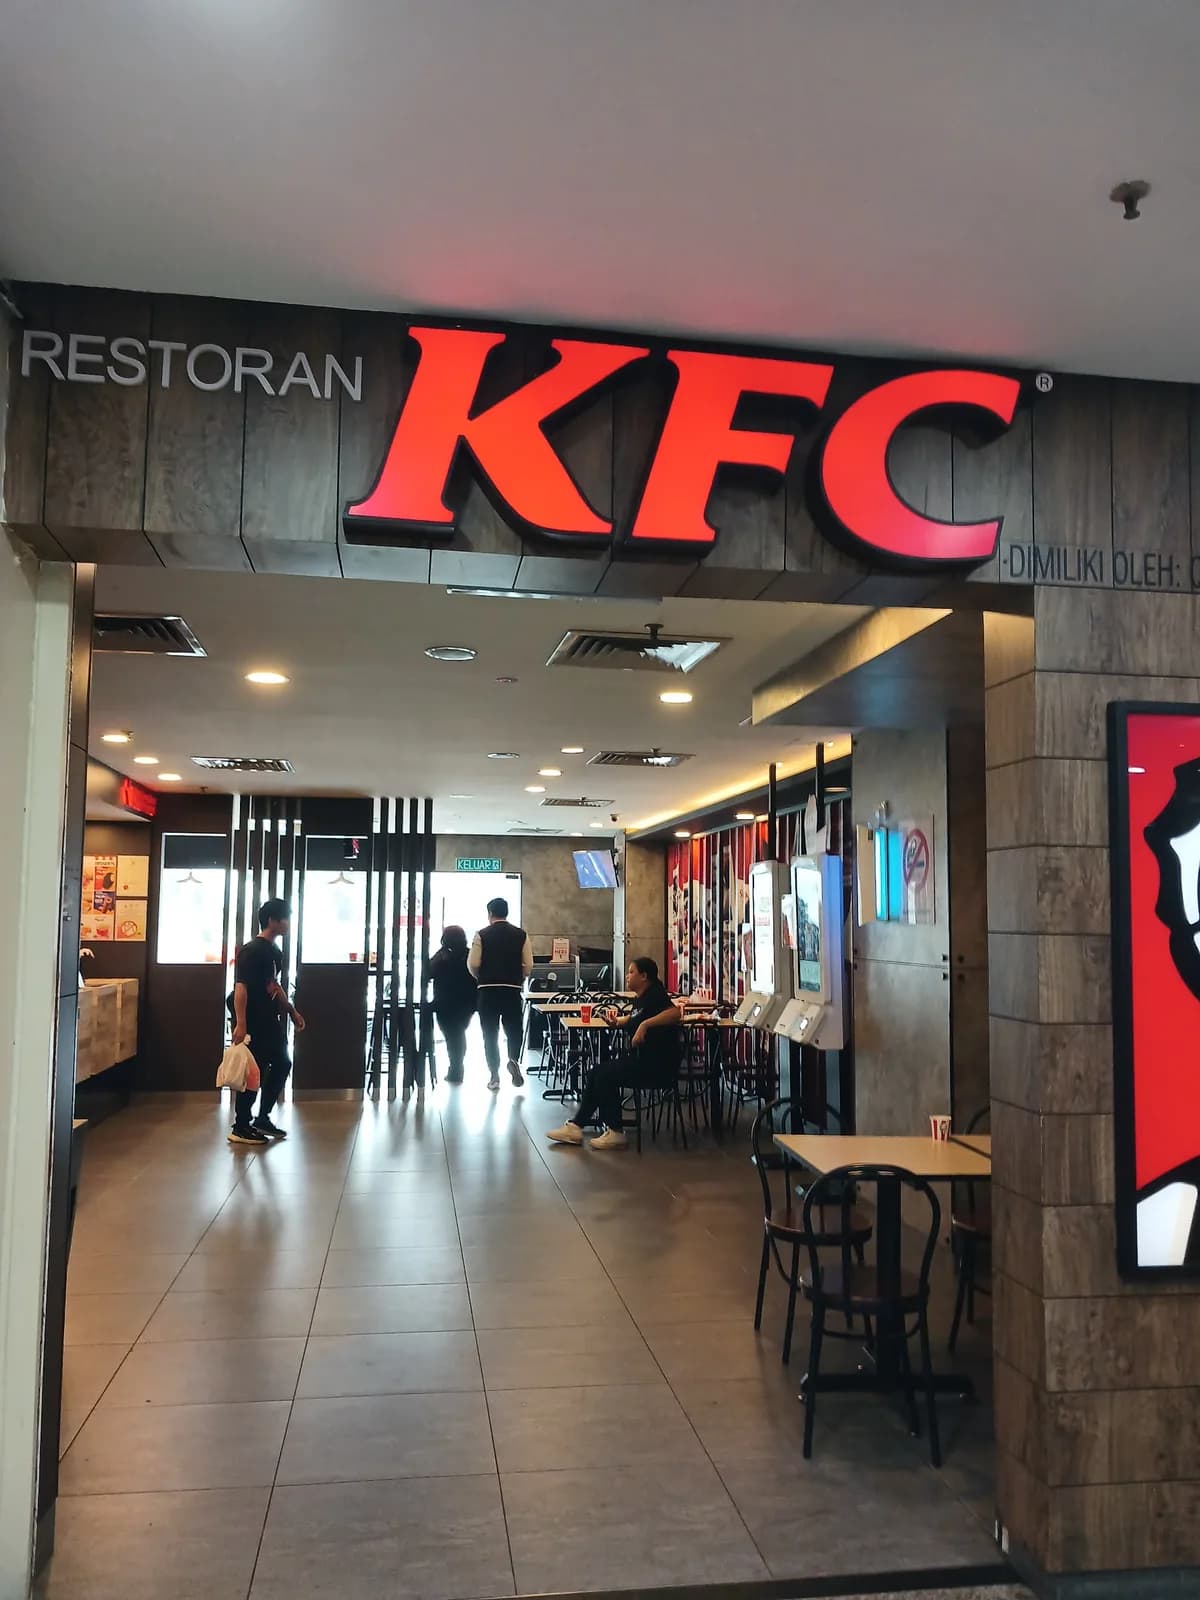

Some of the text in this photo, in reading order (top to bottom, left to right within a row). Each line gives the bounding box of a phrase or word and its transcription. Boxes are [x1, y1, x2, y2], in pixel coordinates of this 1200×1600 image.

[21, 329, 364, 401] RESTORAN
[347, 325, 1021, 560] KFC
[1113, 551, 1180, 587] OLEH:
[457, 859, 492, 870] KELUAR
